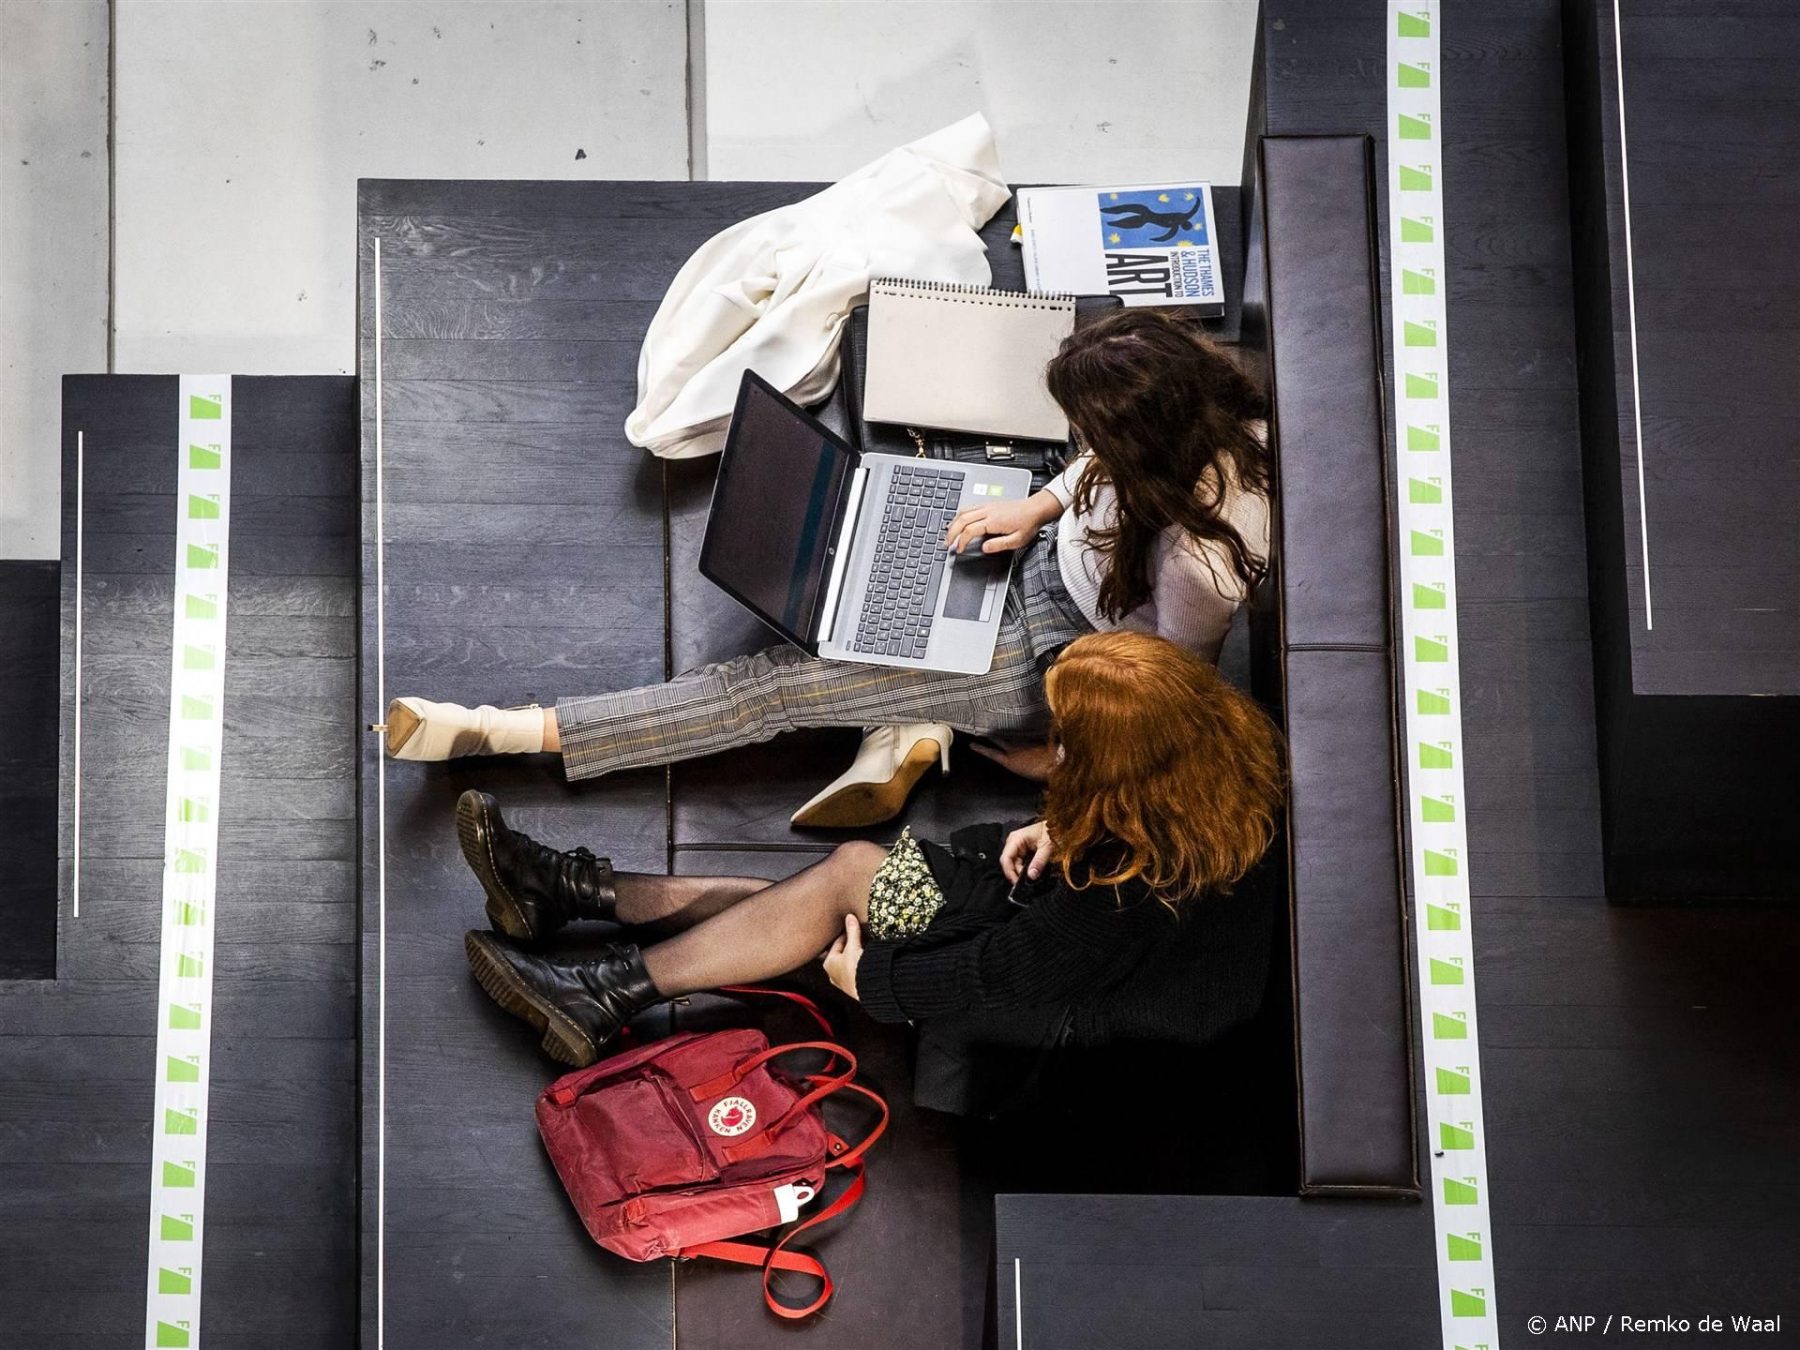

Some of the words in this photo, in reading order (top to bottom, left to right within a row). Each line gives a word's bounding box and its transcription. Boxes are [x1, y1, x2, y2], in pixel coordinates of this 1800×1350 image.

[1105, 253, 1173, 297] ART
[1170, 251, 1183, 290] INTRODUCTION
[1197, 249, 1211, 264] THE
[1181, 259, 1200, 297] HUDSON
[1199, 265, 1214, 296] THAMES
